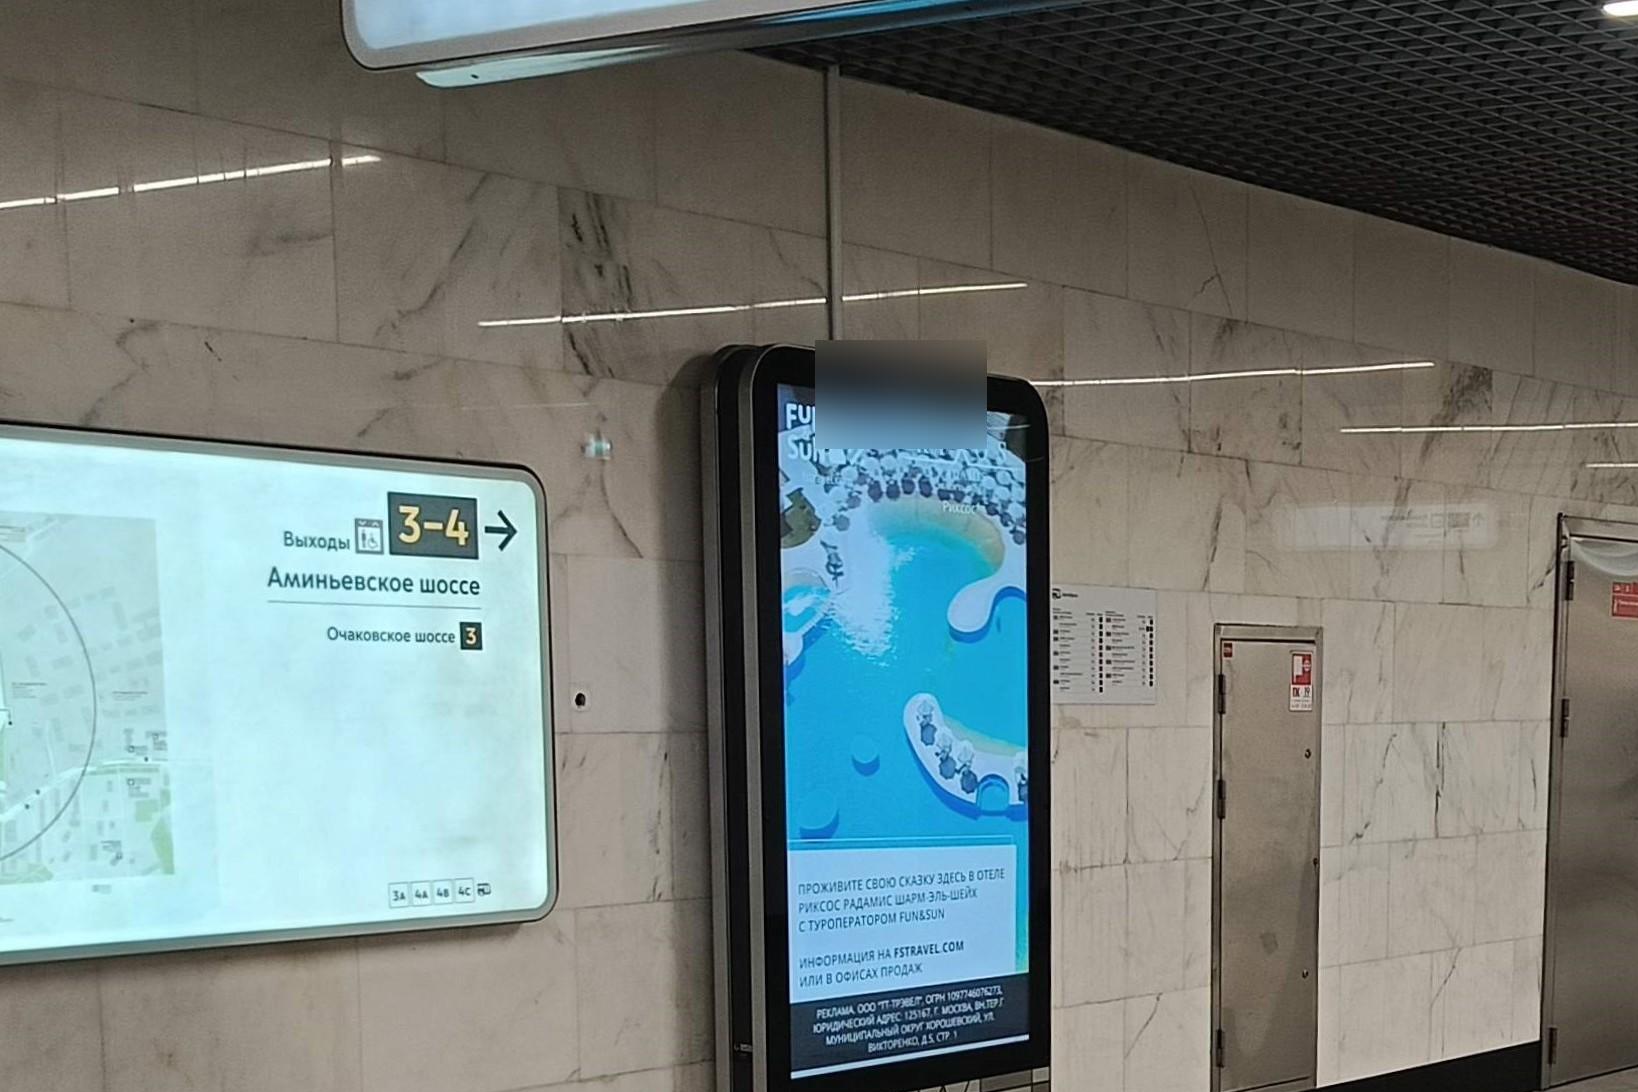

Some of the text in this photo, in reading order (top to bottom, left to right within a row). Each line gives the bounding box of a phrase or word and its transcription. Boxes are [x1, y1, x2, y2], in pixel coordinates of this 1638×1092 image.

[786, 403, 815, 431] FU
[398, 505, 469, 546] 3-4
[283, 530, 351, 551] Выходы
[267, 566, 481, 596] Аминьевское шоссе
[326, 626, 456, 645] Очаковское шоссе
[466, 627, 477, 645] 3
[798, 868, 1005, 896] ПРОЖИВИТЕ СВОЮ СКАЗКУ ЗДЕСЬ В ОТЕЛЕ
[799, 885, 978, 914] РИКСОС РАДАМИС ШАРМ-ЭЛЬ-ШЕЙХ
[799, 907, 945, 933] С ТУРОПЕРАТОРОМ FUN&SUN
[799, 941, 964, 969] ИНФОРМАЦИЯ НА FSTRAVEL.COM
[799, 963, 923, 988] ИЛИ В ОФИСАХ ПРОДАЖ
[857, 1002, 876, 1014] ООО
[925, 993, 945, 1004] ОГРН
[813, 1013, 875, 1033] ЮРИДИЧЕСКИЙ
[825, 1023, 899, 1045] МУНИЦИПАЛЬНЫЙ
[900, 1022, 924, 1034] ОКРУГ
